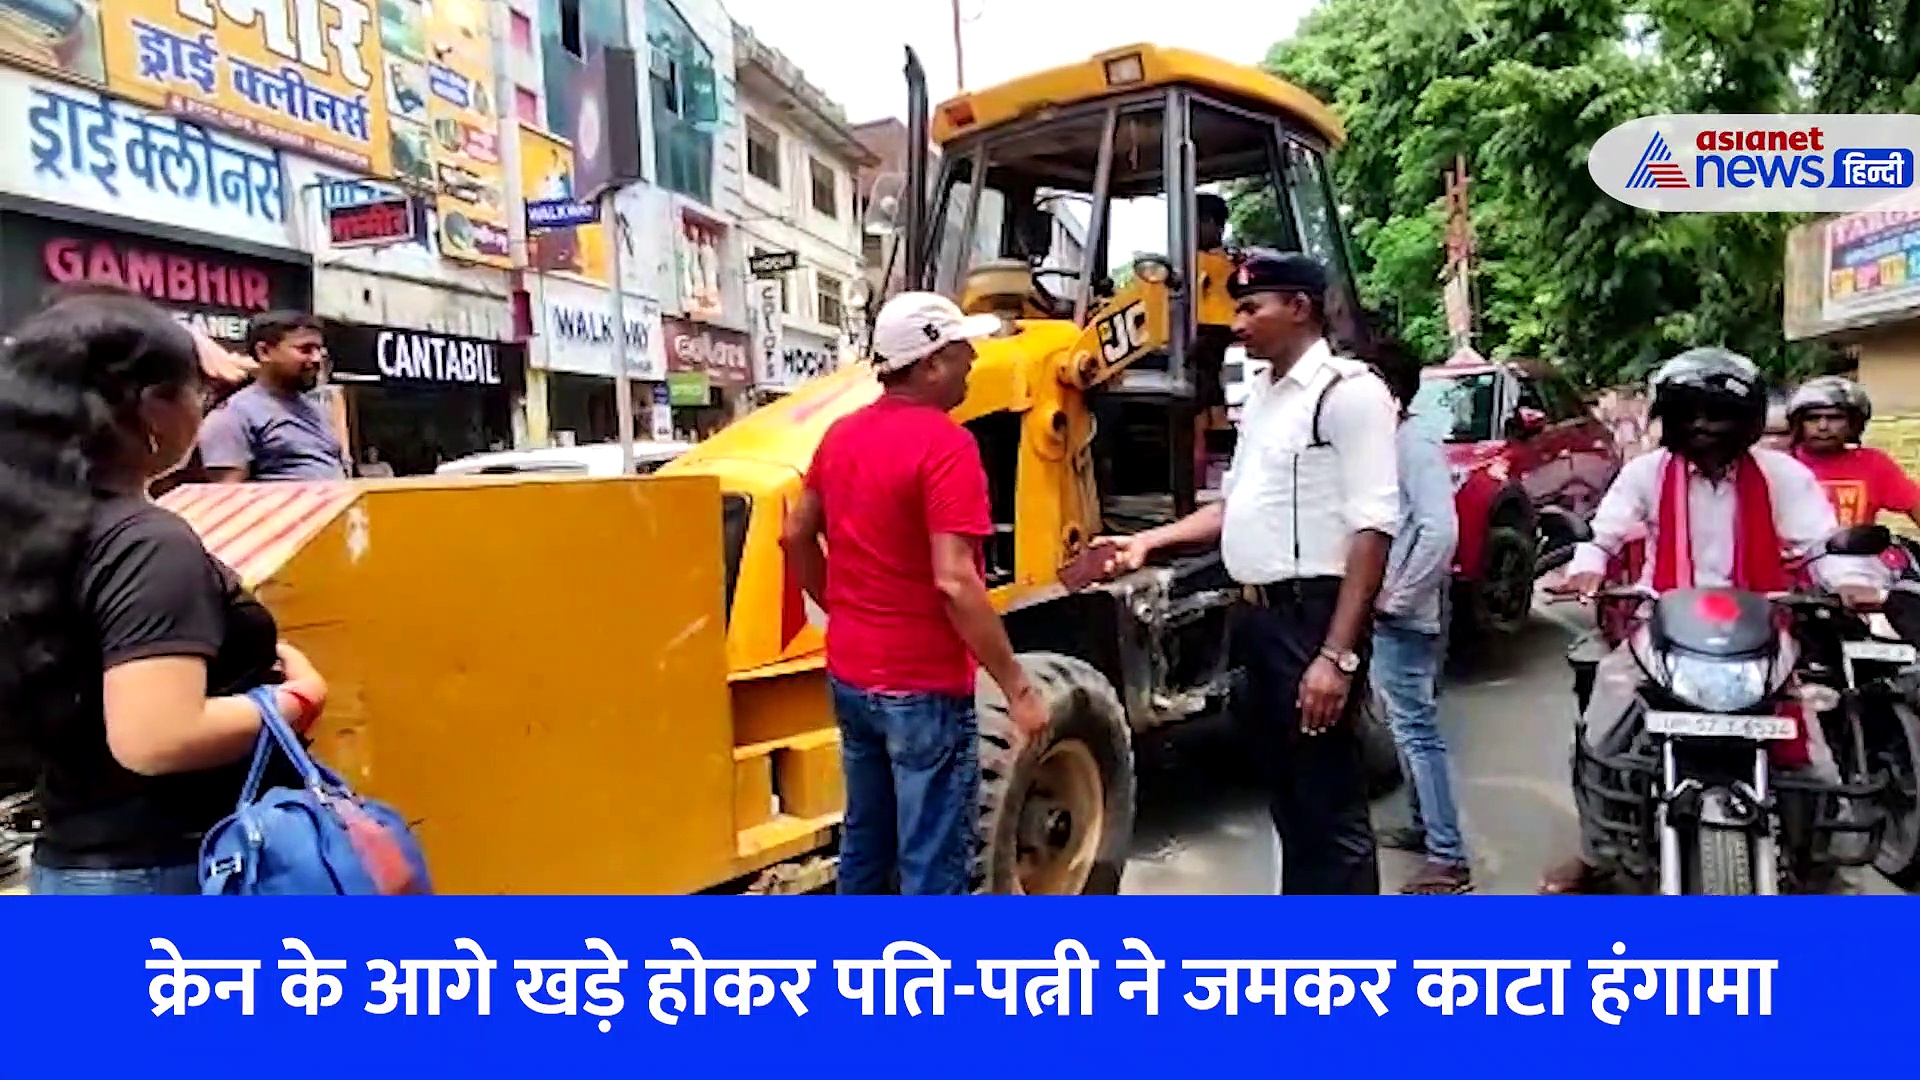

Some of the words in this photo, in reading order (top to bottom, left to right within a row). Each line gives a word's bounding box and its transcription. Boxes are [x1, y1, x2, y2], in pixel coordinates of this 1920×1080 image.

[131, 19, 218, 94] ड्राई
[29, 86, 121, 197] ड्राई
[45, 238, 271, 311] GAMBHIR
[377, 330, 502, 385] CANTABIL
